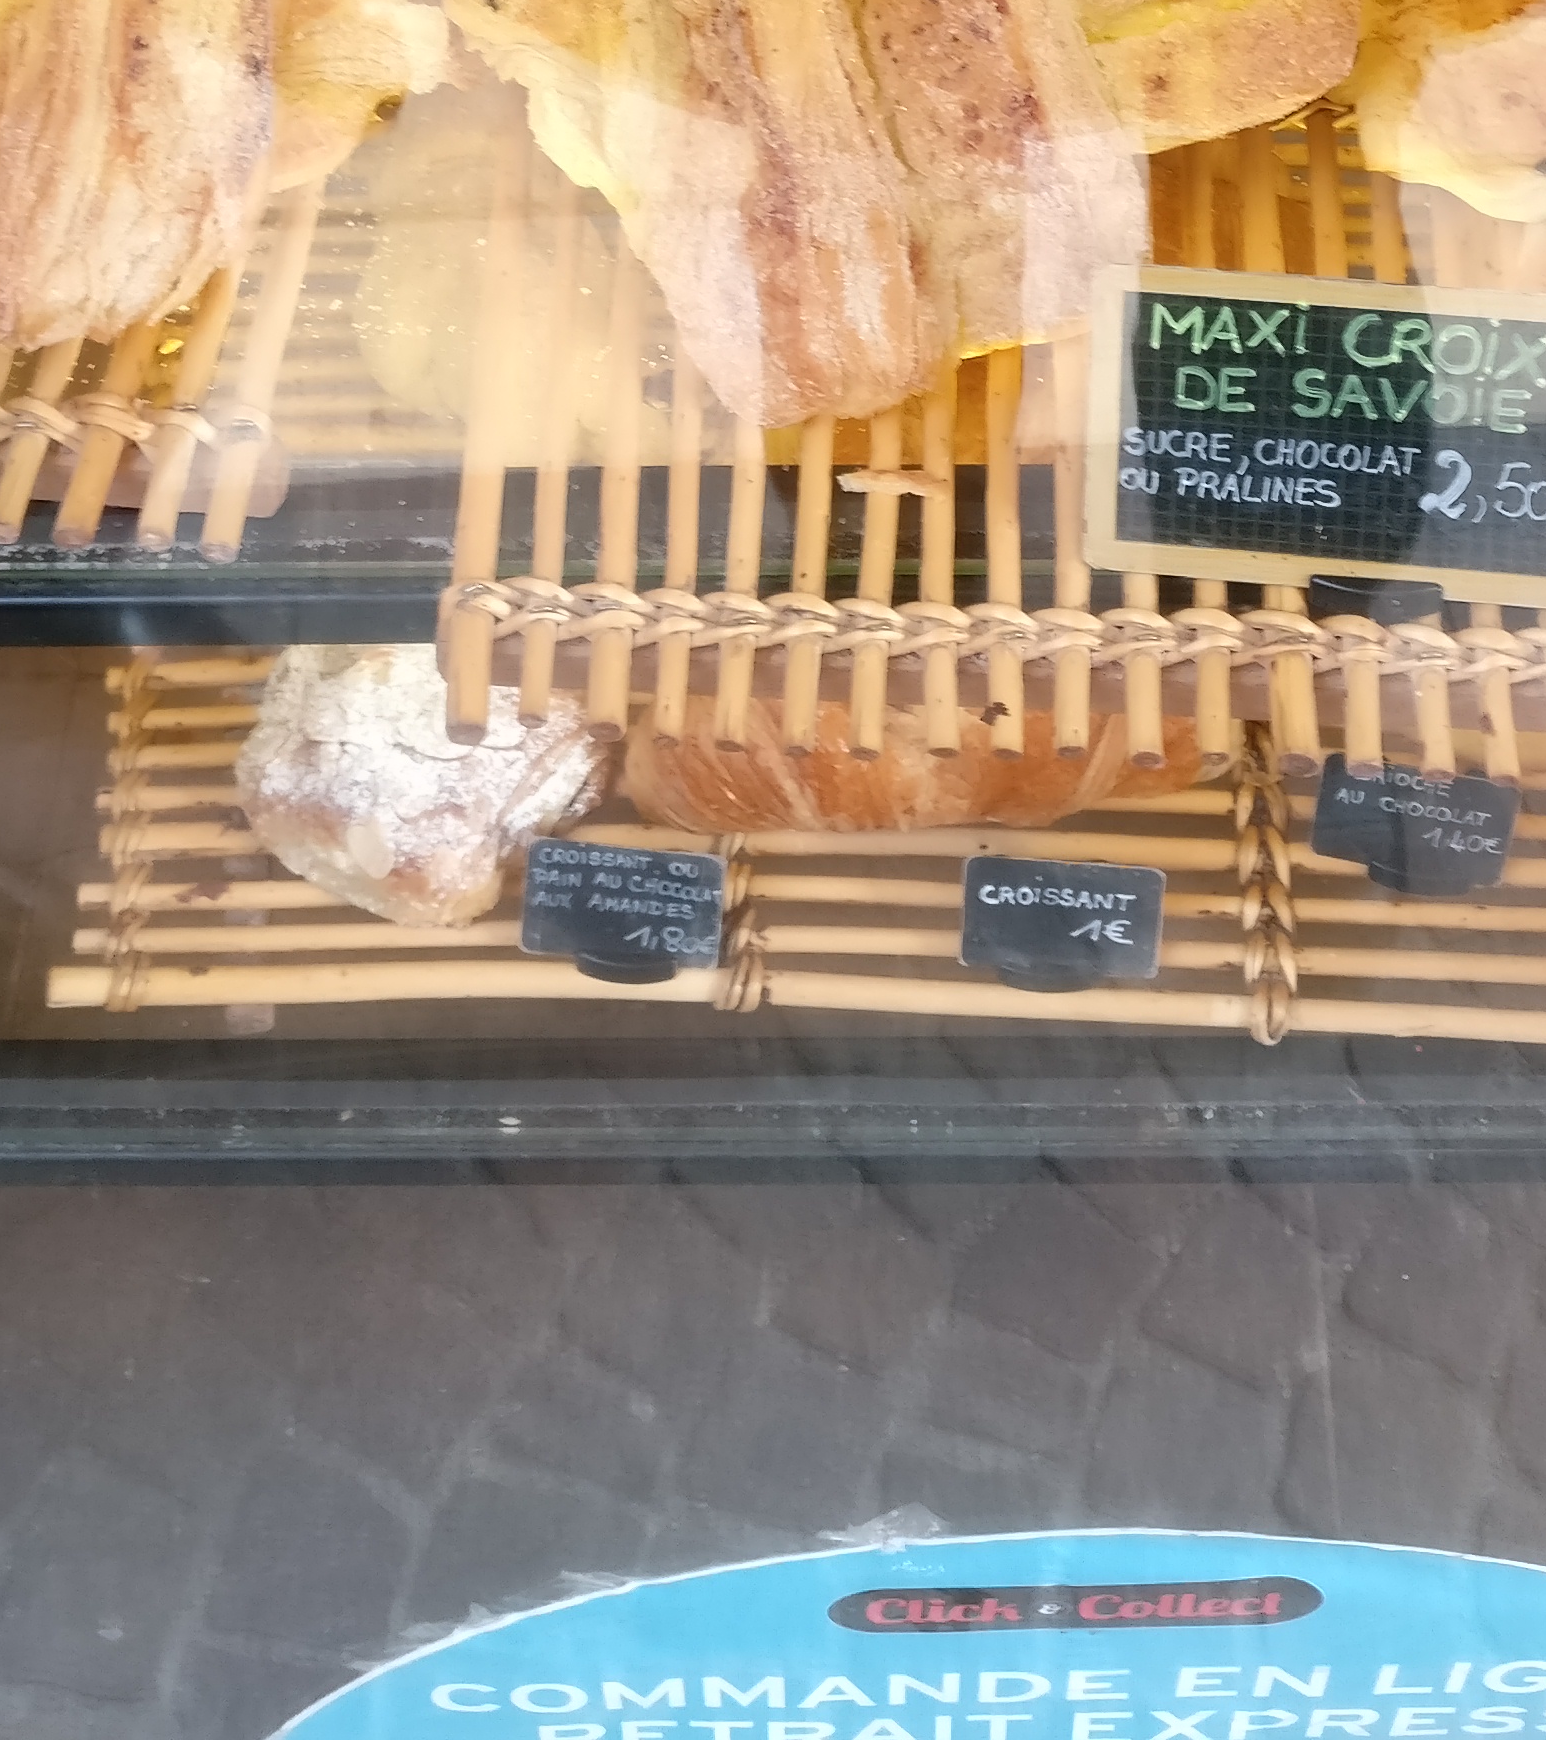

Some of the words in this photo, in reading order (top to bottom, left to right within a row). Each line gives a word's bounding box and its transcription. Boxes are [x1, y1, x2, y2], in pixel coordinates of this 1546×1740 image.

[1173, 365, 1258, 414] DE
[1118, 465, 1160, 496] OU
[1174, 465, 1343, 509] PRALINES
[1334, 786, 1366, 806] AU
[1378, 795, 1493, 828] CHOCOLAT
[591, 871, 622, 890] AU
[529, 890, 573, 910] AUX
[586, 892, 697, 921] AMANDES
[1068, 918, 1135, 947] 1€
[864, 1595, 1024, 1626] Click
[1076, 1591, 1283, 1622] Collect
[430, 1670, 1132, 1714] COMMANDE
[1174, 1665, 1331, 1699] EN
